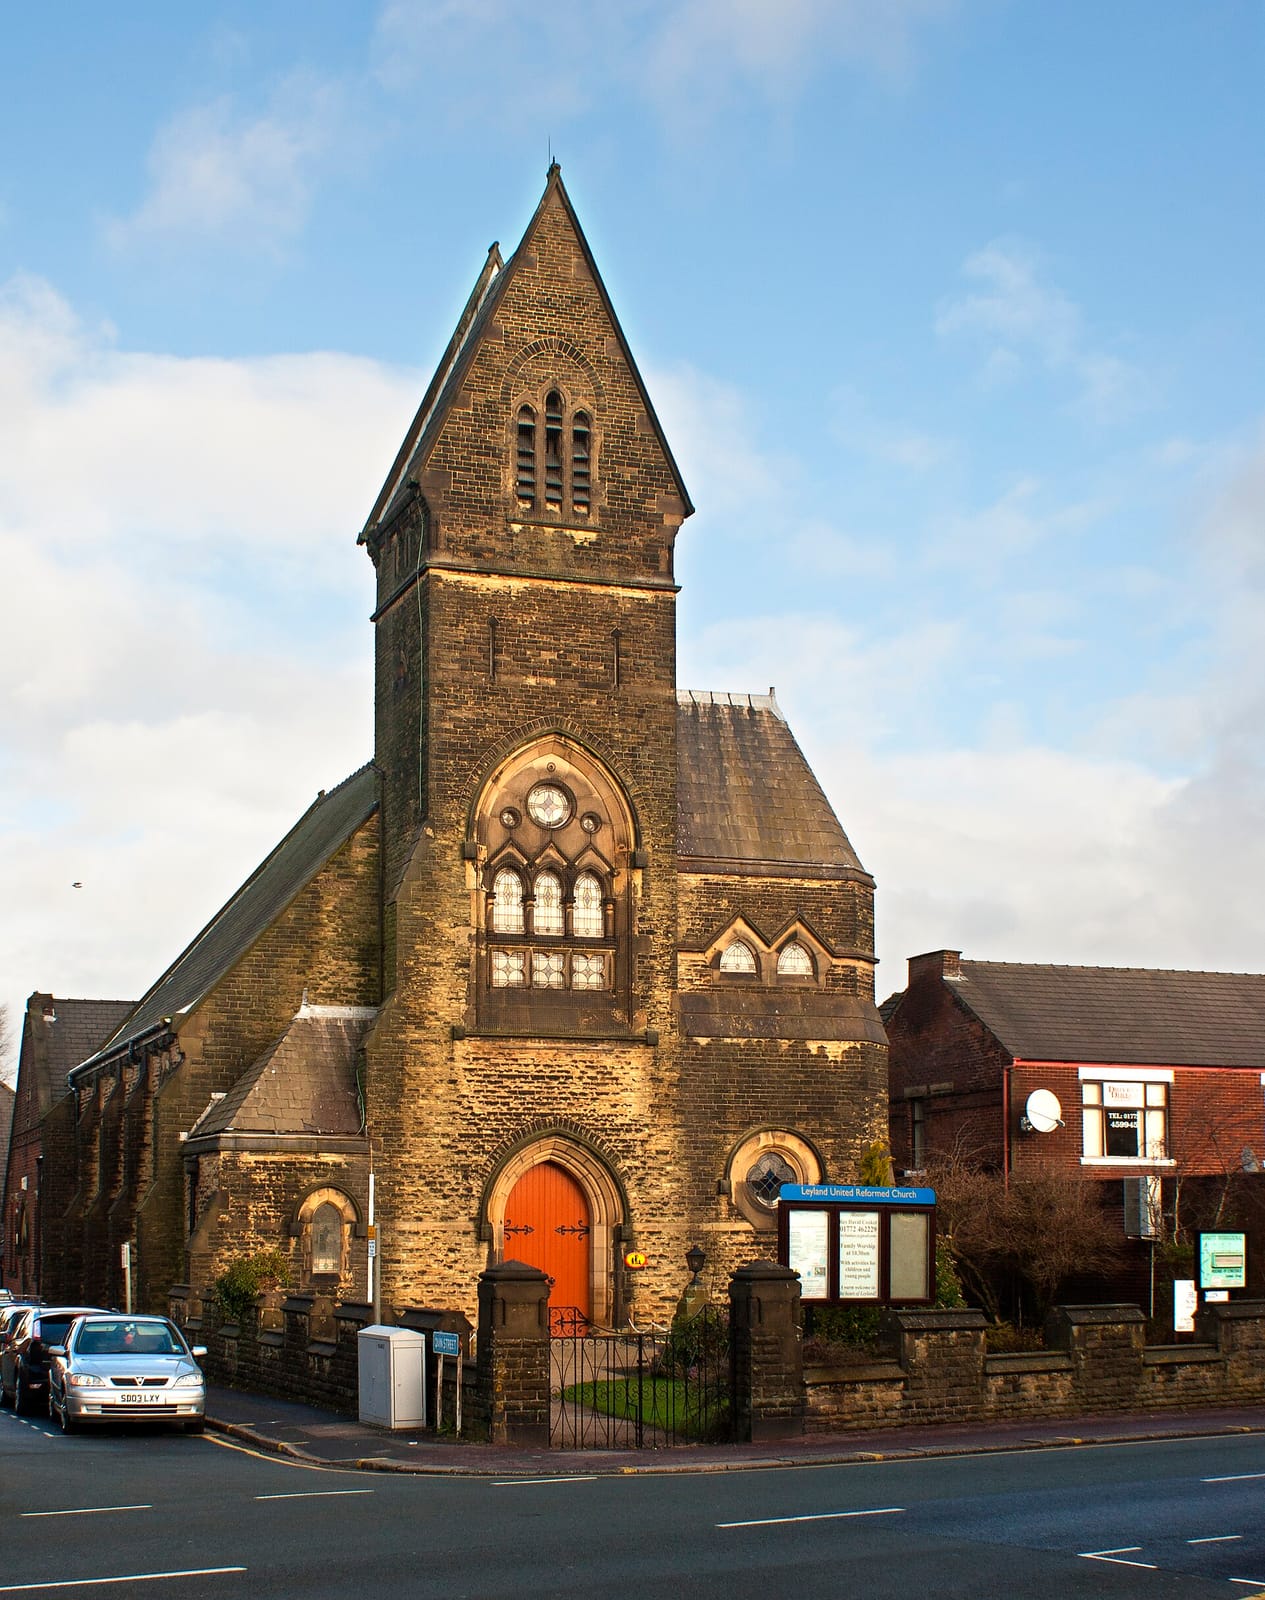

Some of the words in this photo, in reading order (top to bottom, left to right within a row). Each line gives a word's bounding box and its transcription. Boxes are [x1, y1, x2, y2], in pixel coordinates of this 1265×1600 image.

[801, 1187, 828, 1199] Leyland
[829, 1187, 854, 1197] United
[856, 1188, 890, 1198] Reformed
[891, 1189, 917, 1199] Church
[121, 1394, 143, 1403] SD03
[144, 1394, 160, 1403] LXY
